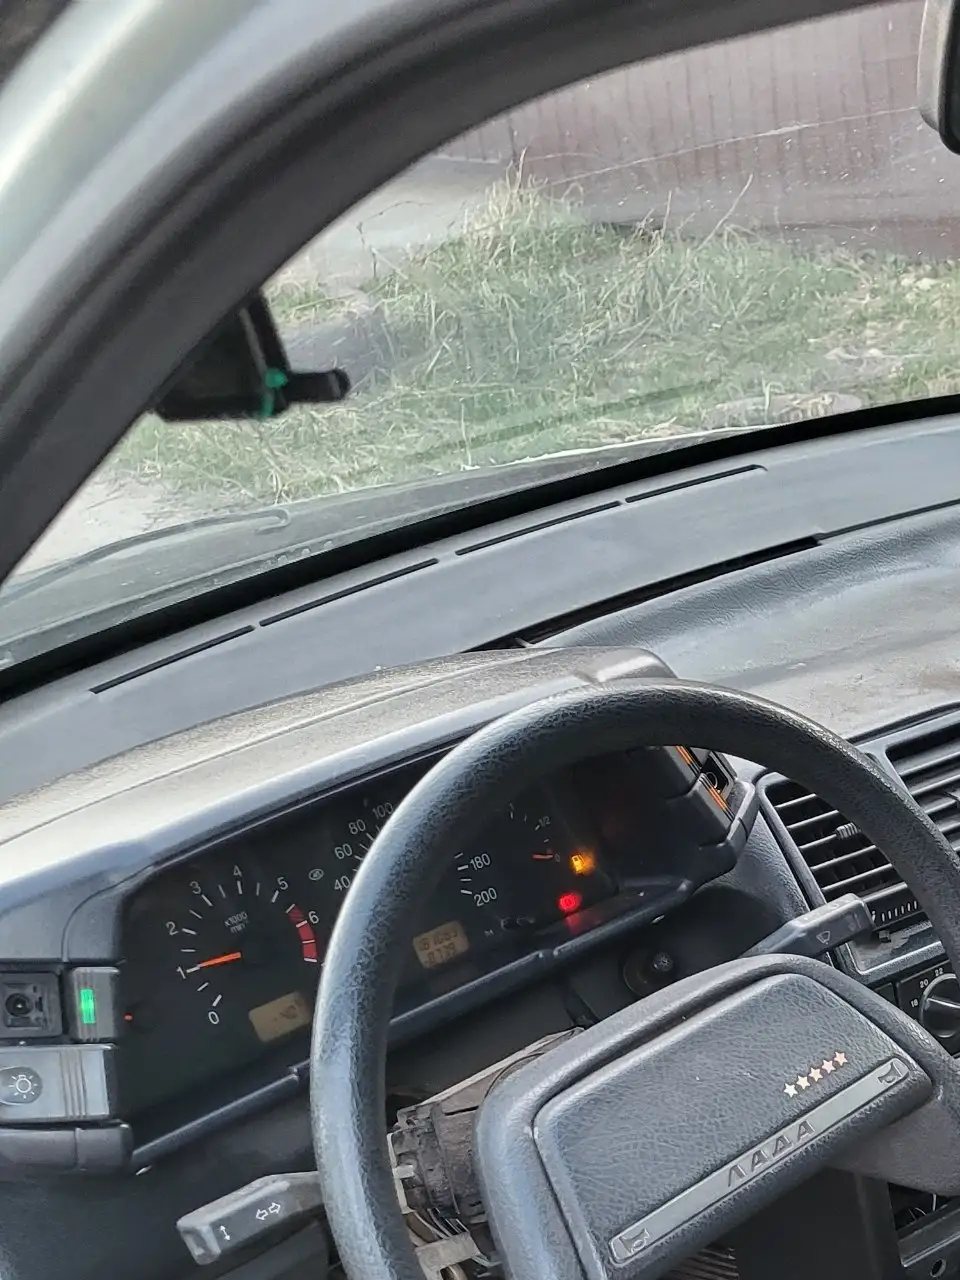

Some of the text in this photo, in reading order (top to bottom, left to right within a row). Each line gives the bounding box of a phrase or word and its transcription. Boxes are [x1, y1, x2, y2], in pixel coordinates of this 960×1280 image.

[372, 802, 394, 820] 100
[348, 818, 366, 835] 80
[334, 843, 353, 860] 60
[470, 853, 491, 871] 180
[233, 865, 242, 877] 4
[189, 880, 201, 894] 3
[277, 876, 289, 890] 5
[334, 875, 351, 891] 40
[473, 887, 498, 906] 200
[308, 910, 319, 924] 6
[166, 921, 178, 935] 2
[176, 966, 186, 979] 1
[920, 978, 929, 988] 20
[208, 1011, 220, 1025] 0
